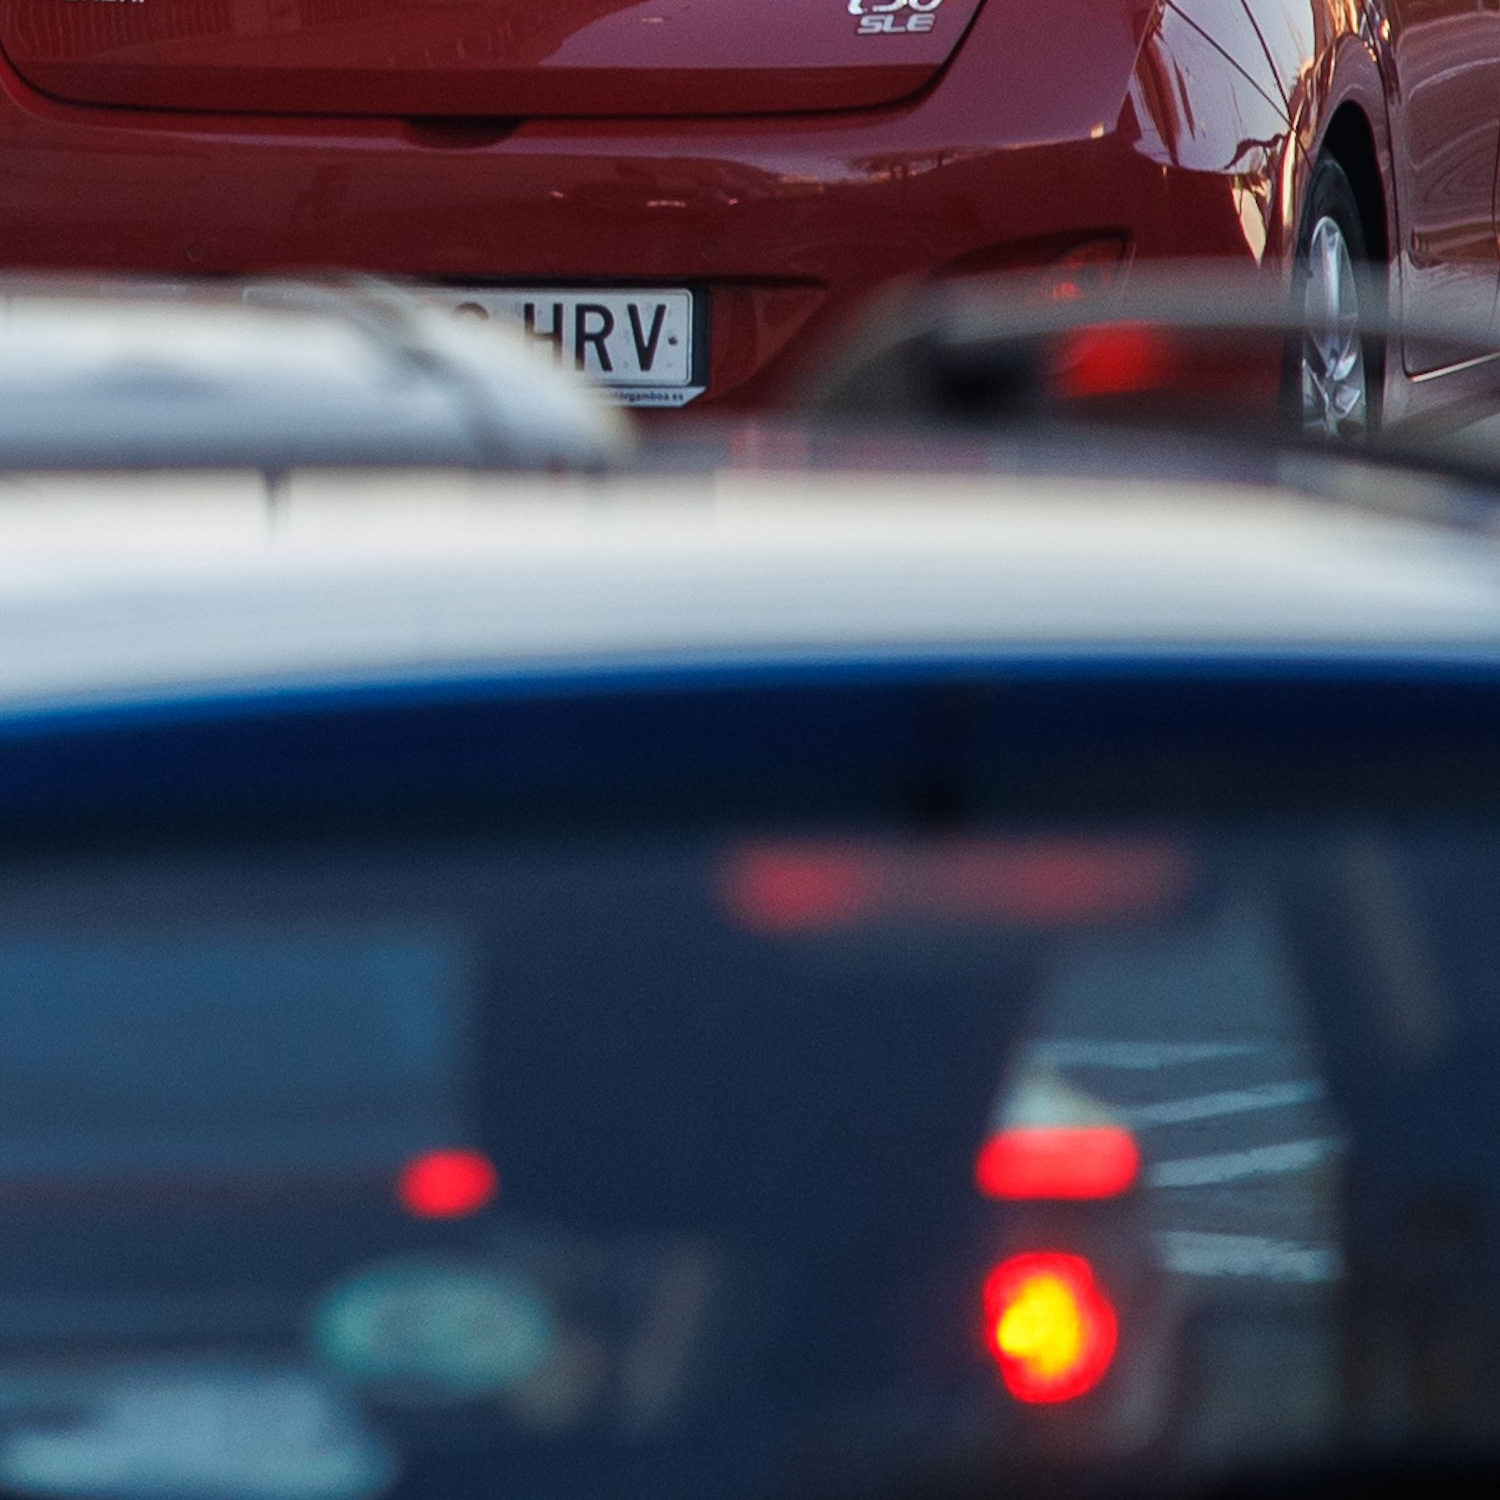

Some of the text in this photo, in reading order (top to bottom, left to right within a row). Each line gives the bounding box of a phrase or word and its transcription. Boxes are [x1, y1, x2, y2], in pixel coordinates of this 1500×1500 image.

[856, 13, 936, 34] SLE
[522, 302, 668, 373] HRV
[614, 389, 685, 403] orgamboa.es
